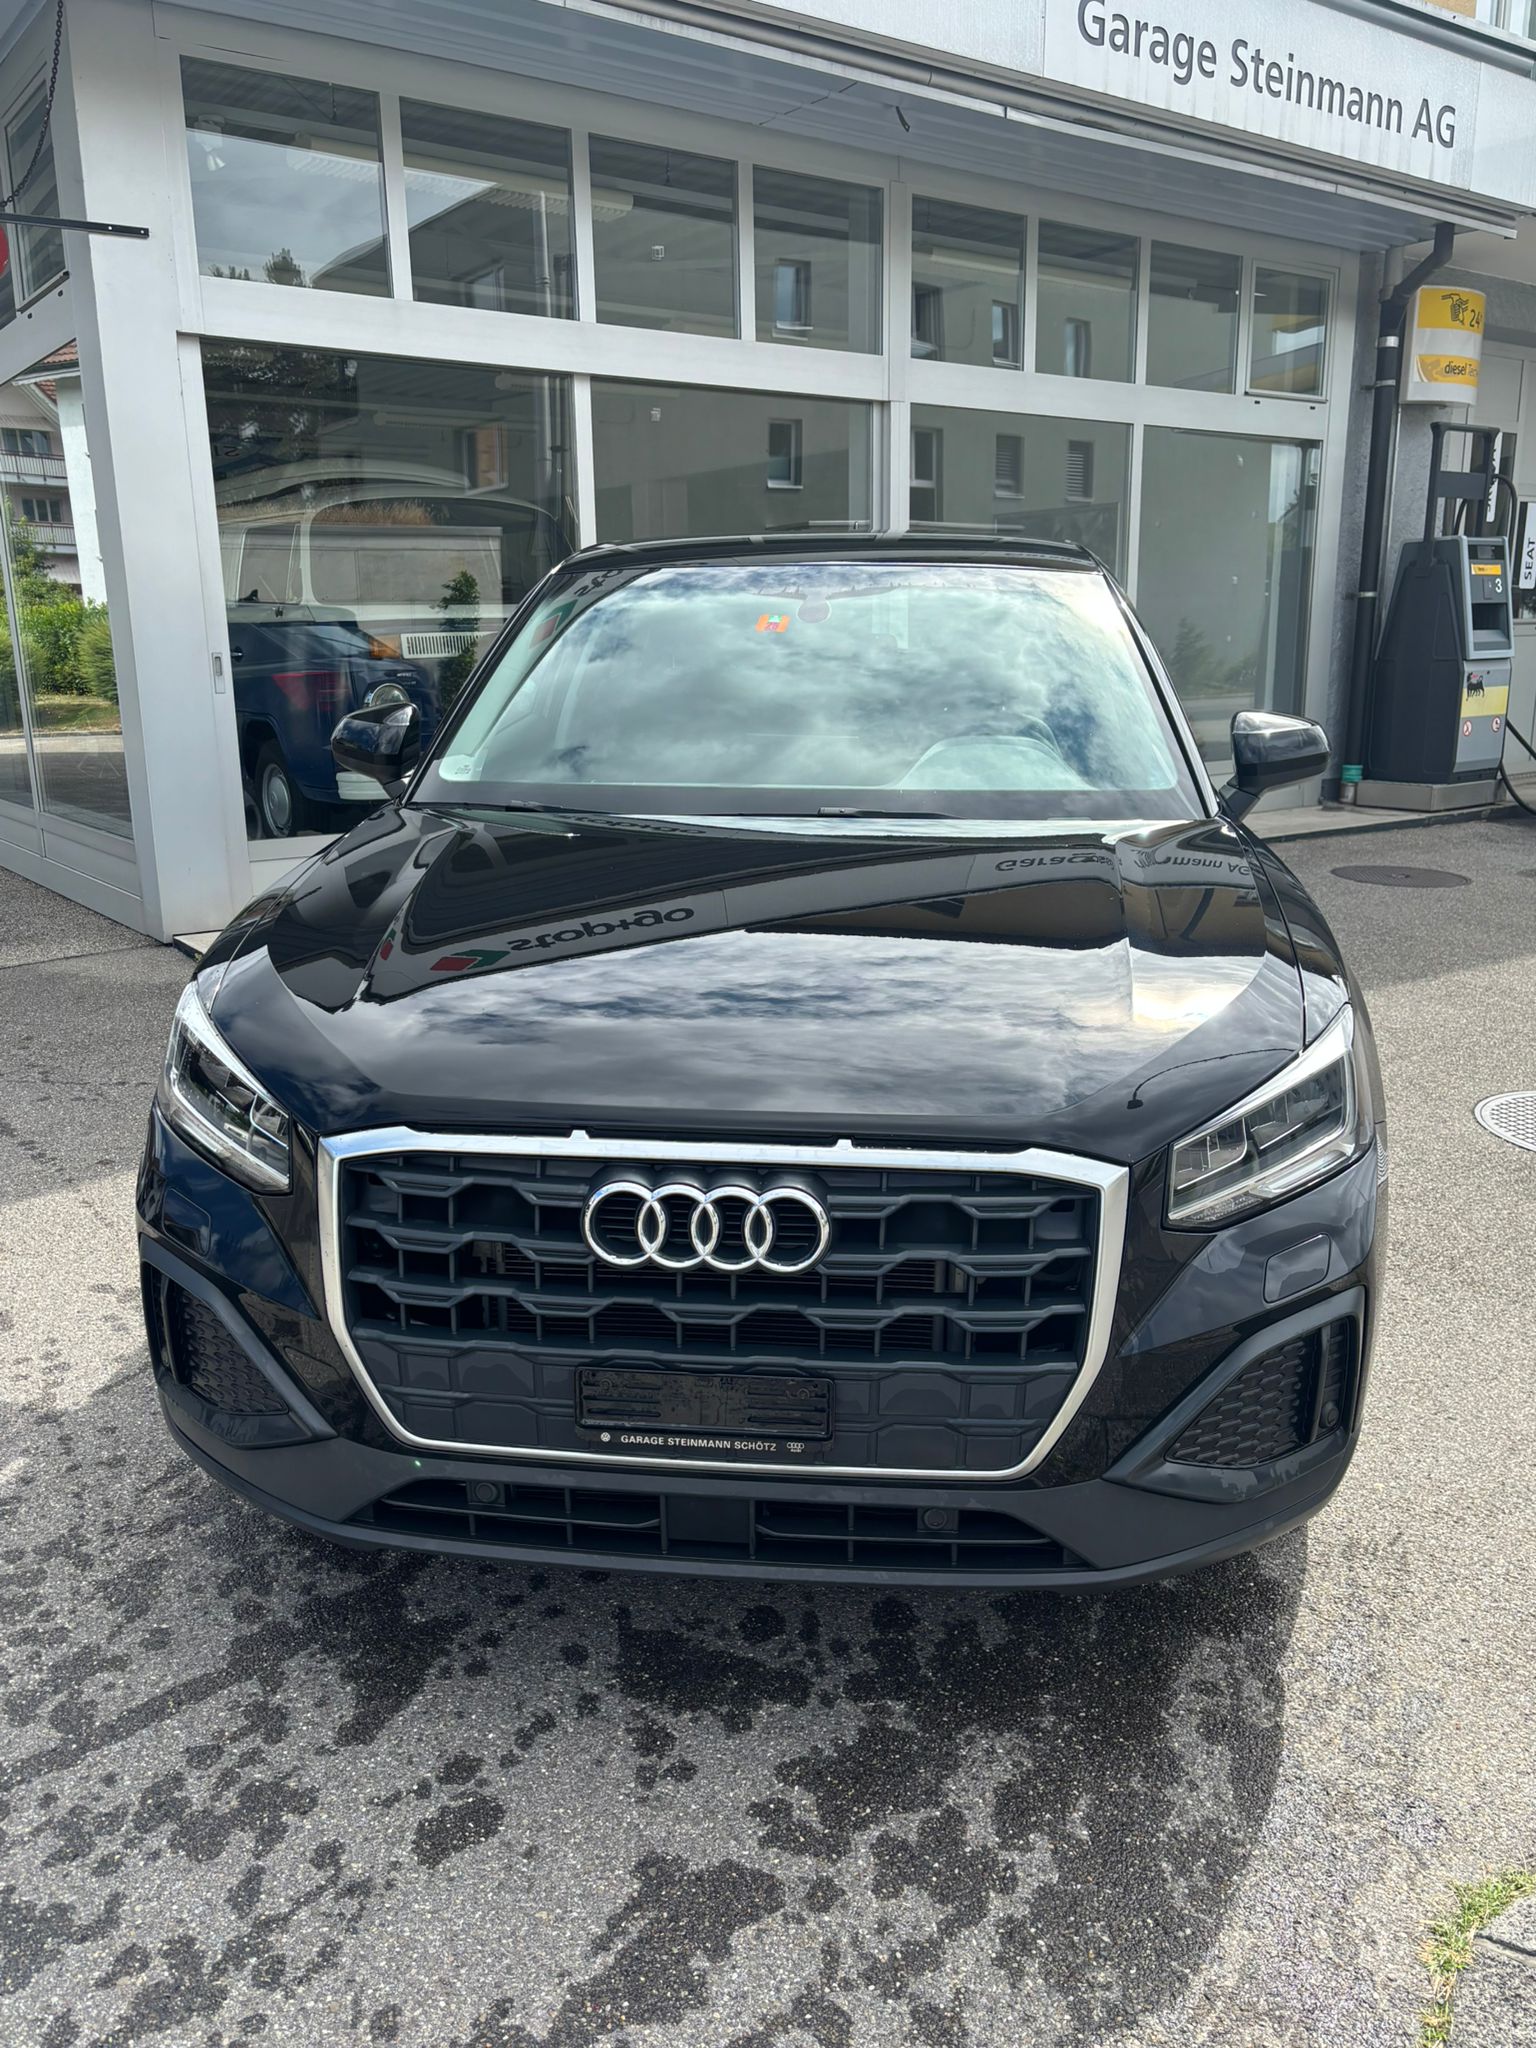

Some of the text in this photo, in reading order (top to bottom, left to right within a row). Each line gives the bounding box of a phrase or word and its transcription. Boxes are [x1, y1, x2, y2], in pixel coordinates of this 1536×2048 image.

[1077, 0, 1456, 149] Garage Steinmann AG
[1444, 361, 1467, 376] diesel
[1524, 537, 1536, 580] SEAT
[1495, 578, 1503, 593] 3
[620, 1434, 665, 1446] GARAGE
[667, 1437, 731, 1450] STEINMANN
[734, 1440, 777, 1452] SCHÖTZ
